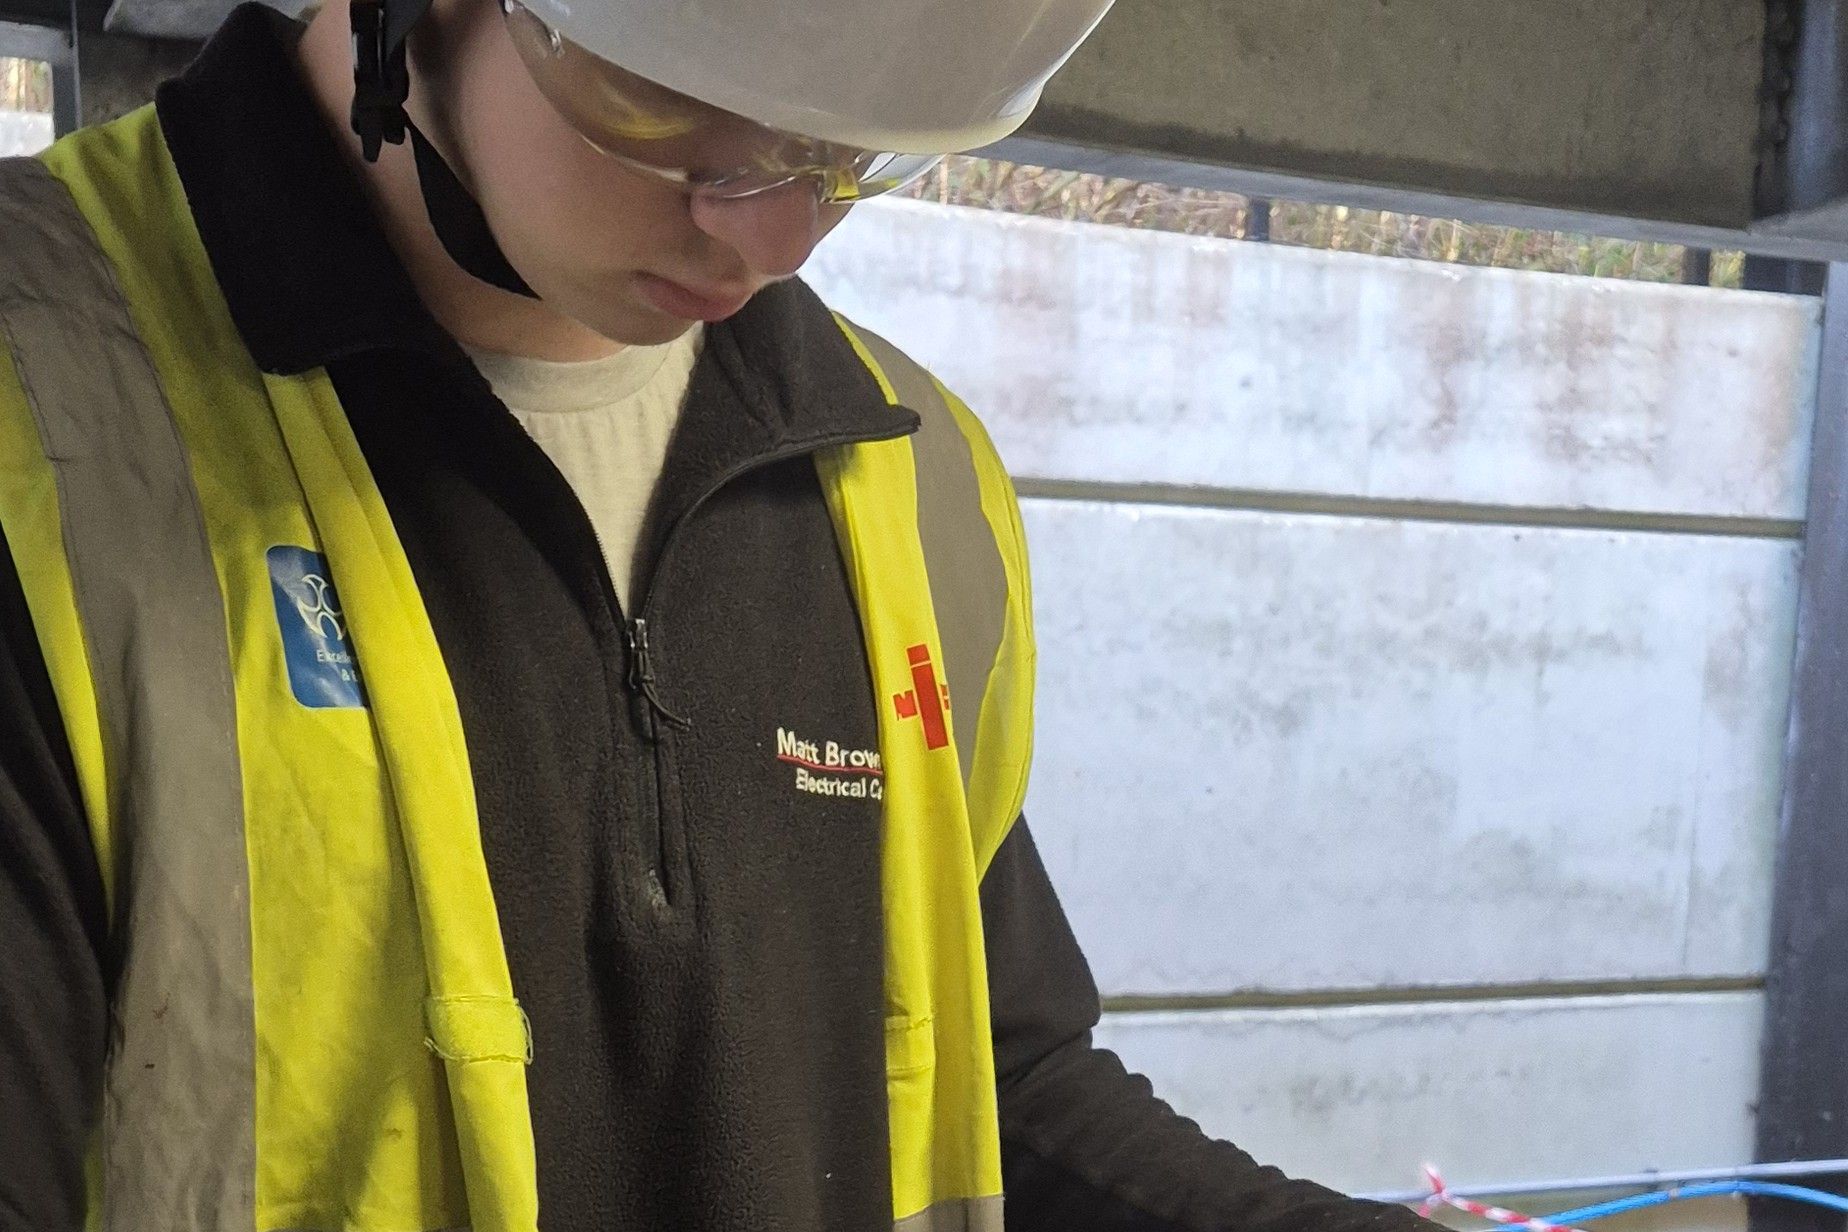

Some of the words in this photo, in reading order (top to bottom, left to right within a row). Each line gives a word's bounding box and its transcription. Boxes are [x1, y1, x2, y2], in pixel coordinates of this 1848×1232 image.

[777, 726, 820, 765] Matt
[825, 740, 881, 769] Brow
[796, 767, 867, 798] Electrical
